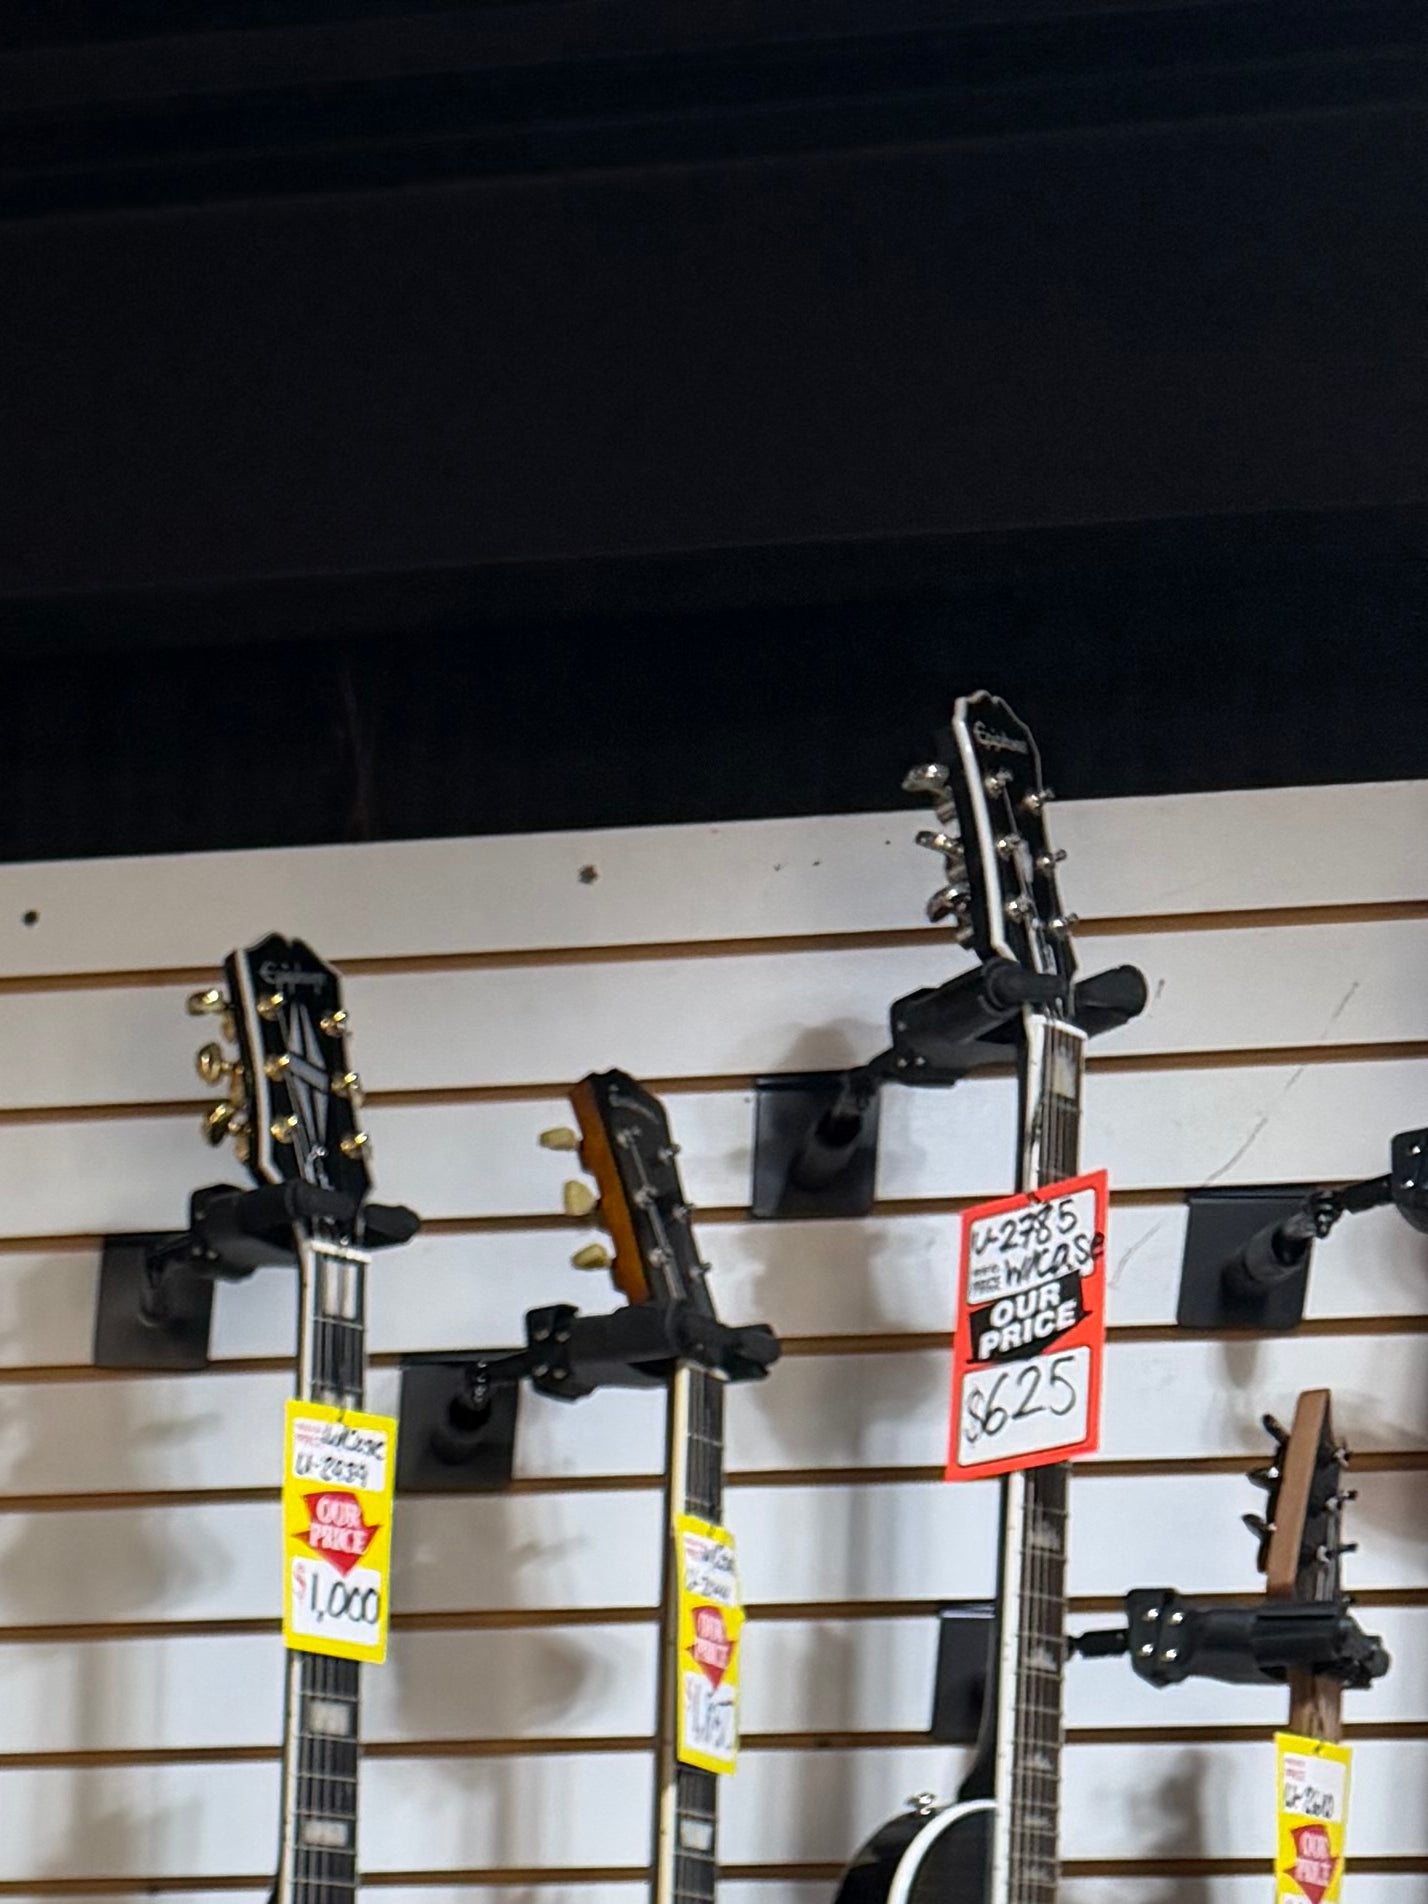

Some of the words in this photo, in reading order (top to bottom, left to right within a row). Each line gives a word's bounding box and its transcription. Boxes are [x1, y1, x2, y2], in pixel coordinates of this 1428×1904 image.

[990, 1281, 1061, 1328] OUR
[978, 1298, 1078, 1361] PRICE
[963, 1356, 1077, 1445] $625
[314, 1495, 362, 1528] OUR
[308, 1521, 369, 1556] PRICE
